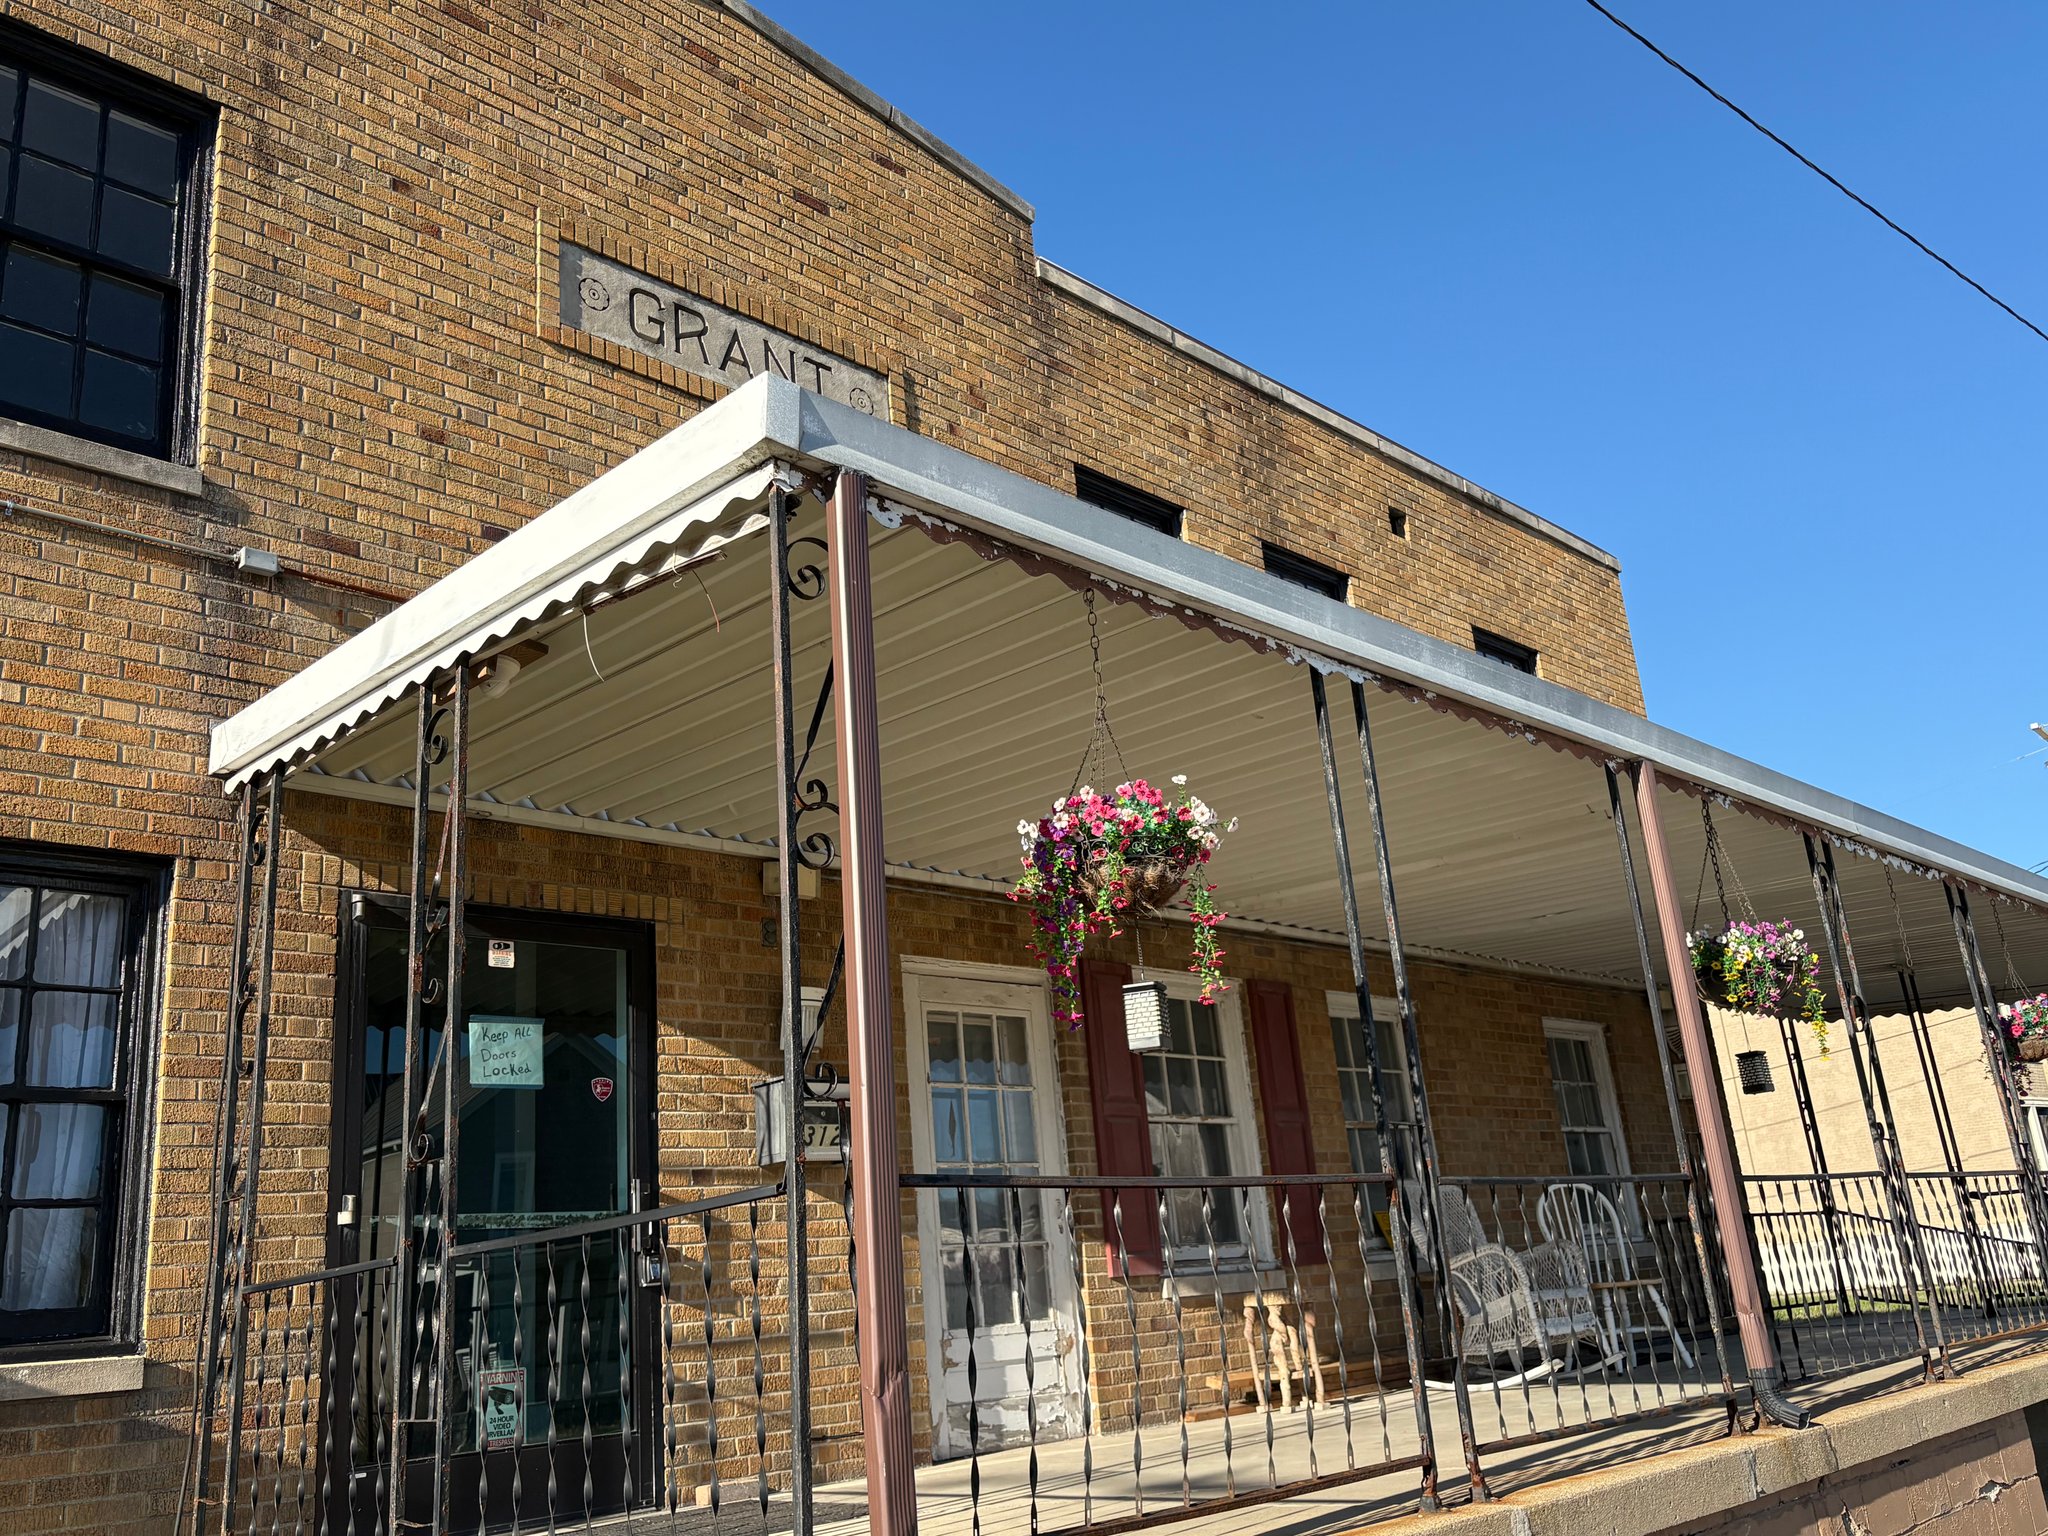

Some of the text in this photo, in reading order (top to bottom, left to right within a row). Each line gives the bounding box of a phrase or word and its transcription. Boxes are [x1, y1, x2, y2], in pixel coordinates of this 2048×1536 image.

[628, 287, 834, 395] GRANT
[482, 1026, 508, 1043] Keep
[481, 1049, 517, 1062] Doors
[804, 1126, 840, 1146] 312
[493, 1422, 511, 1430] VIDEO
[497, 1415, 514, 1423] HOUR
